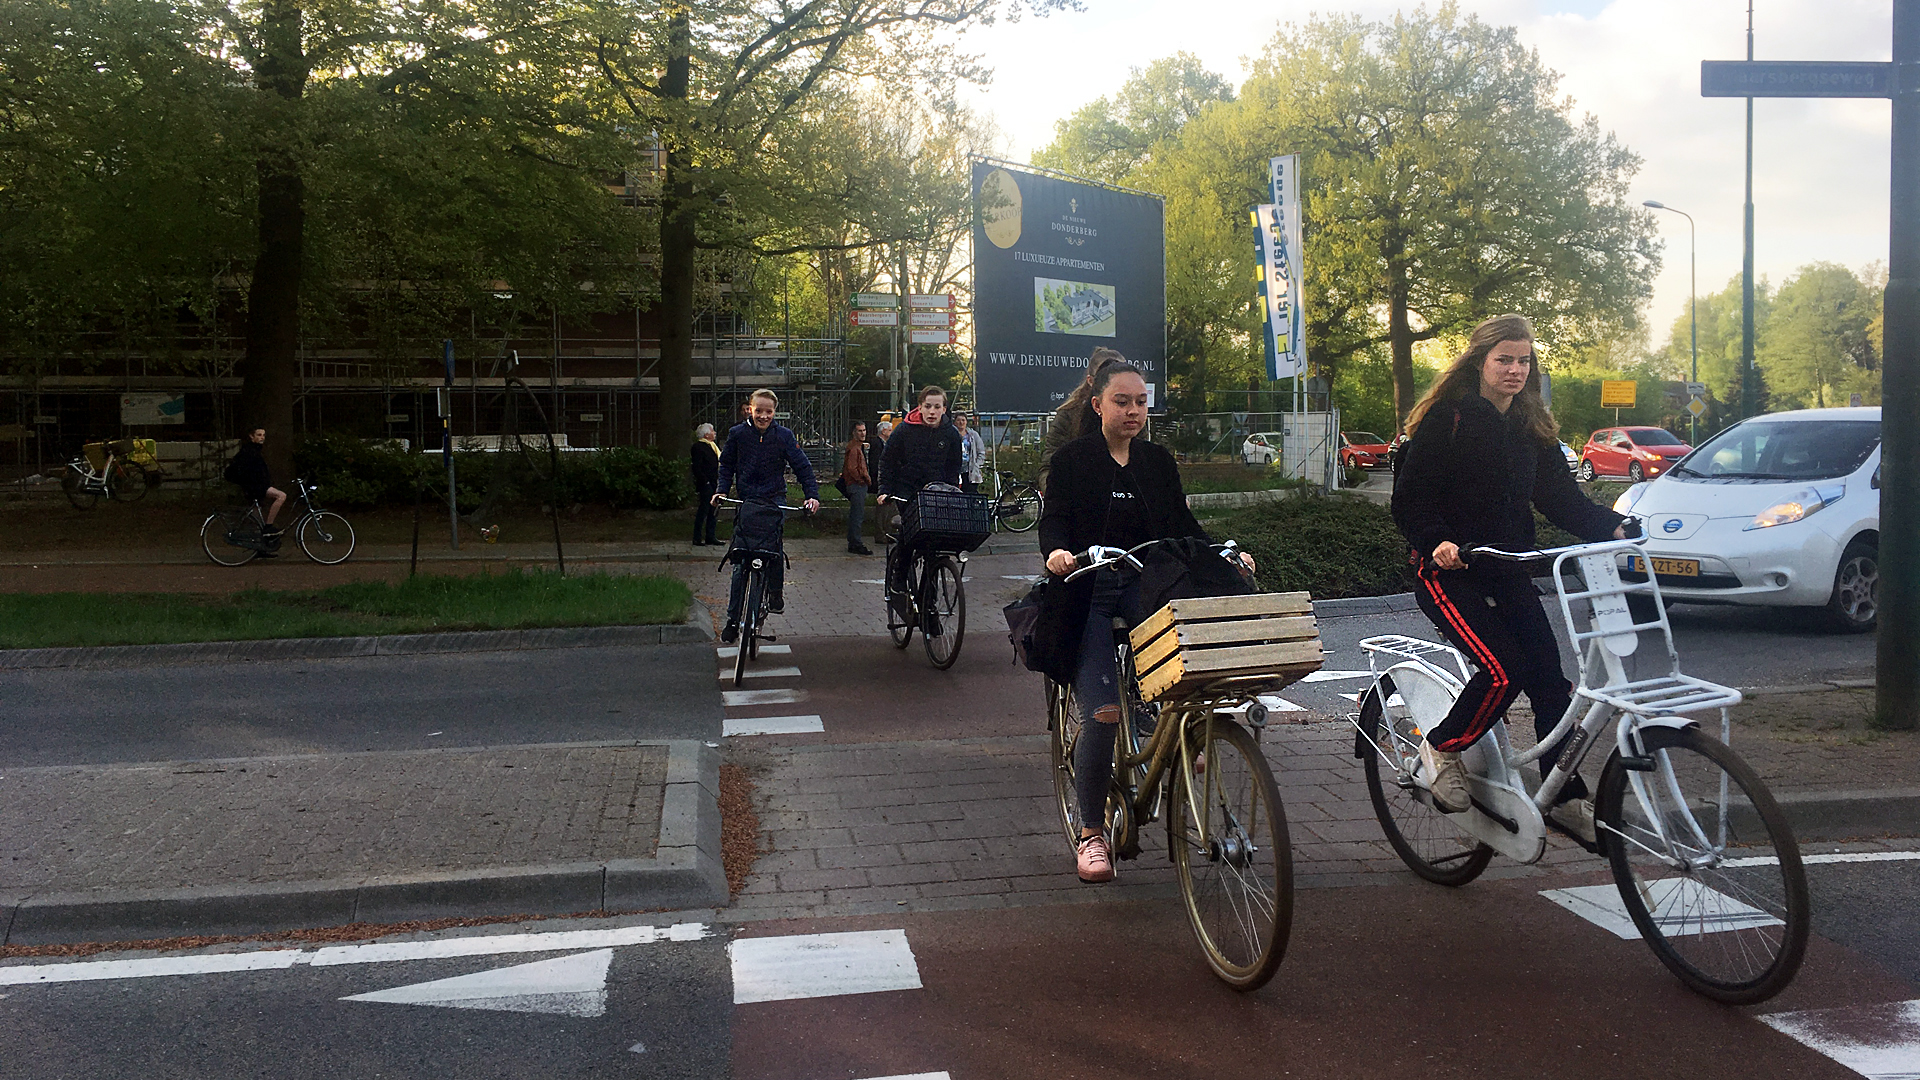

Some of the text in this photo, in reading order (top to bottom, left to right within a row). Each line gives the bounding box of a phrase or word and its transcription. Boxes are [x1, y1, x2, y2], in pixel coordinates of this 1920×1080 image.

[1051, 222, 1098, 237] DONDERBERG
[1014, 251, 1021, 260] 17
[1055, 257, 1105, 271] APPARTEMENTEN
[1638, 560, 1693, 575] 5XZT-56
[1597, 606, 1627, 617] POPAL
